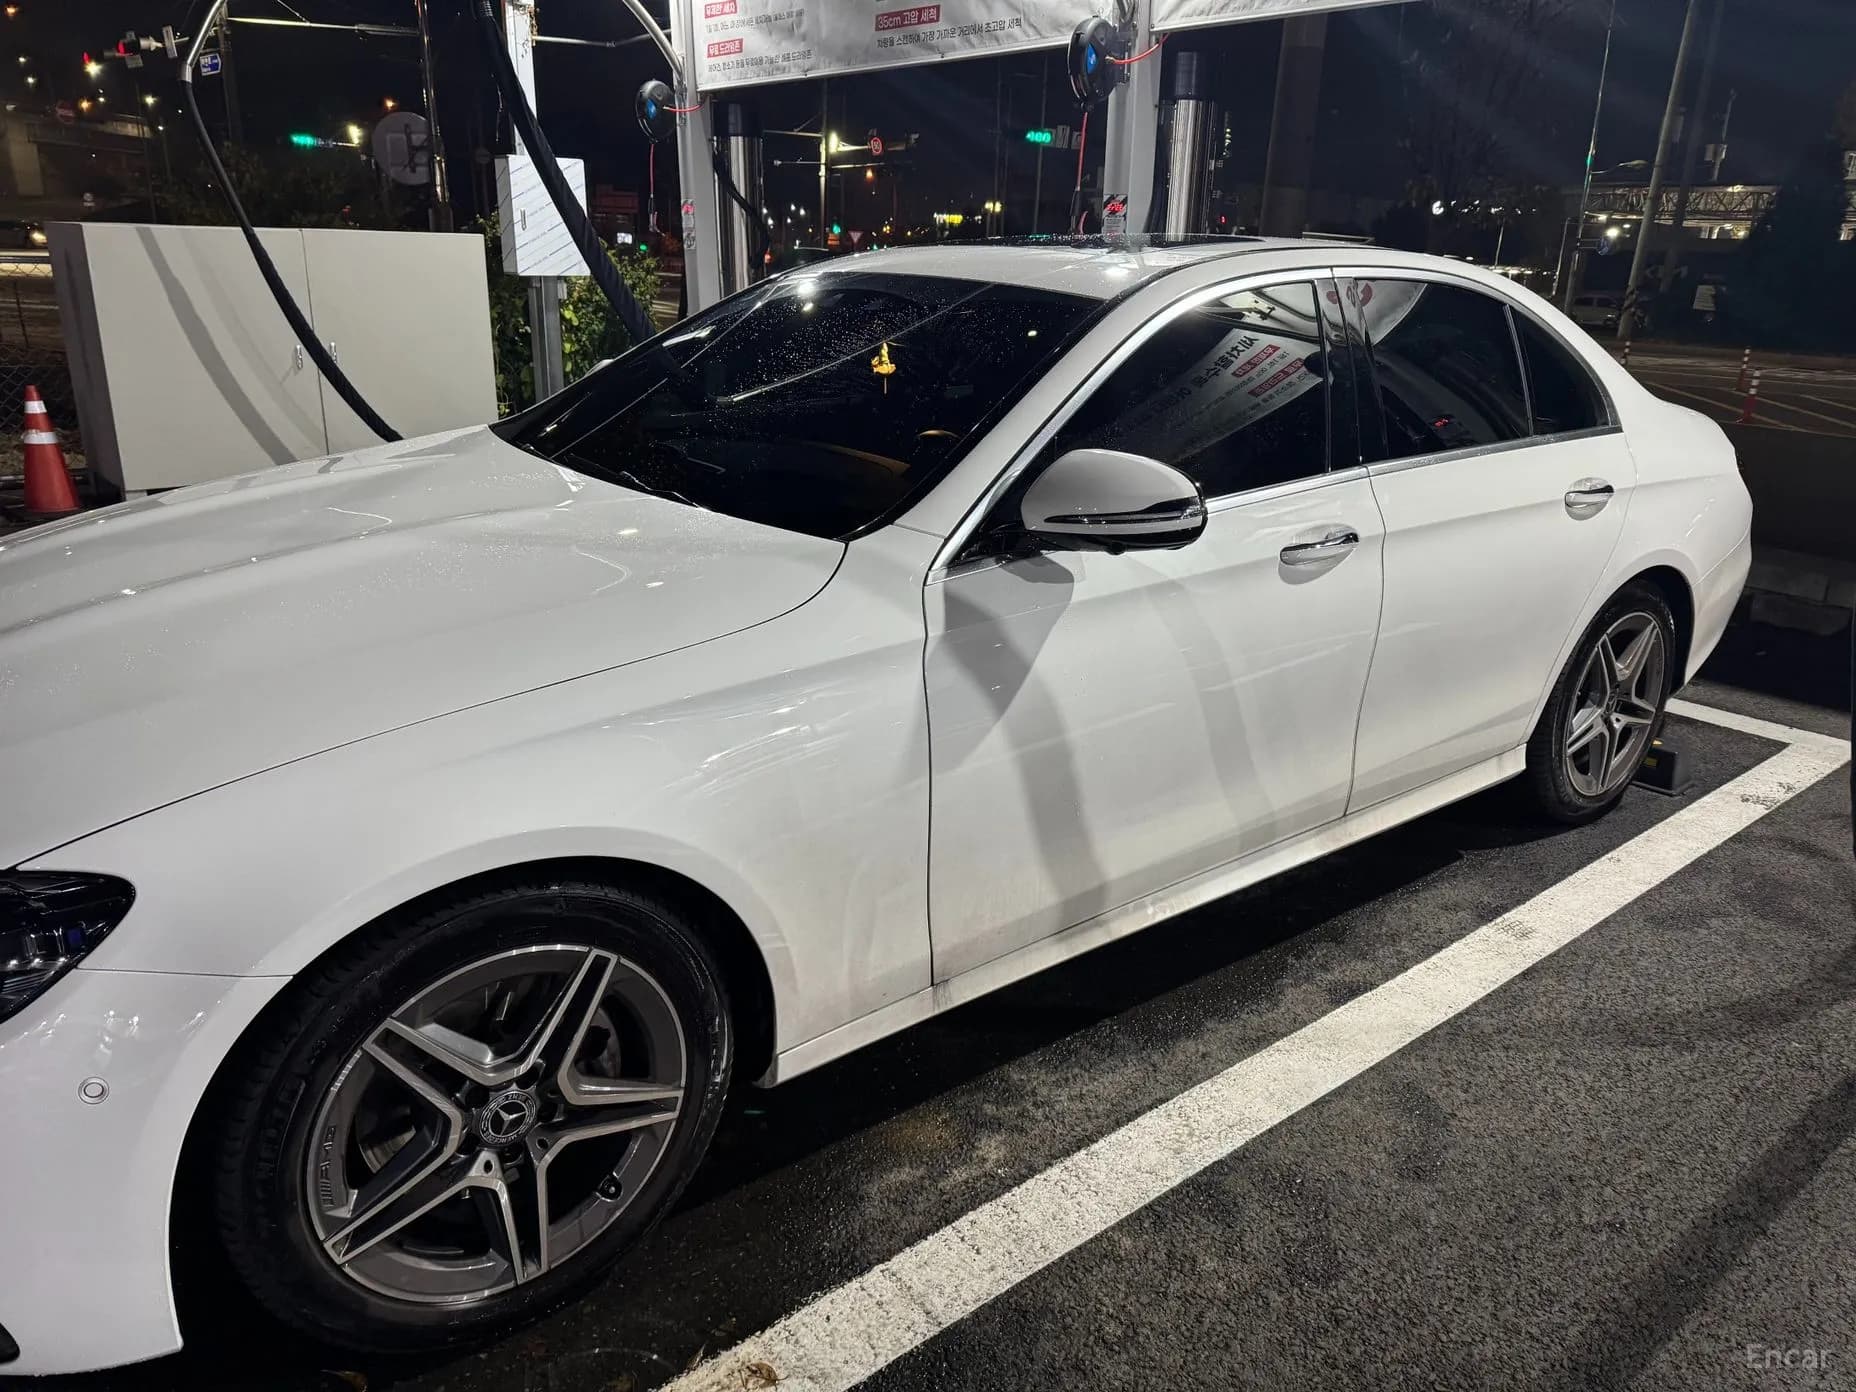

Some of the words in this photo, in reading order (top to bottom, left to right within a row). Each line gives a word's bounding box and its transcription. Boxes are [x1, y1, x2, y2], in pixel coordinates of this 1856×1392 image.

[706, 4, 721, 16] 무제한
[723, 1, 736, 14] 세차
[878, 15, 901, 28] 35cm
[903, 10, 919, 24] 고압
[920, 7, 937, 22] 세척
[922, 30, 935, 42] 가장
